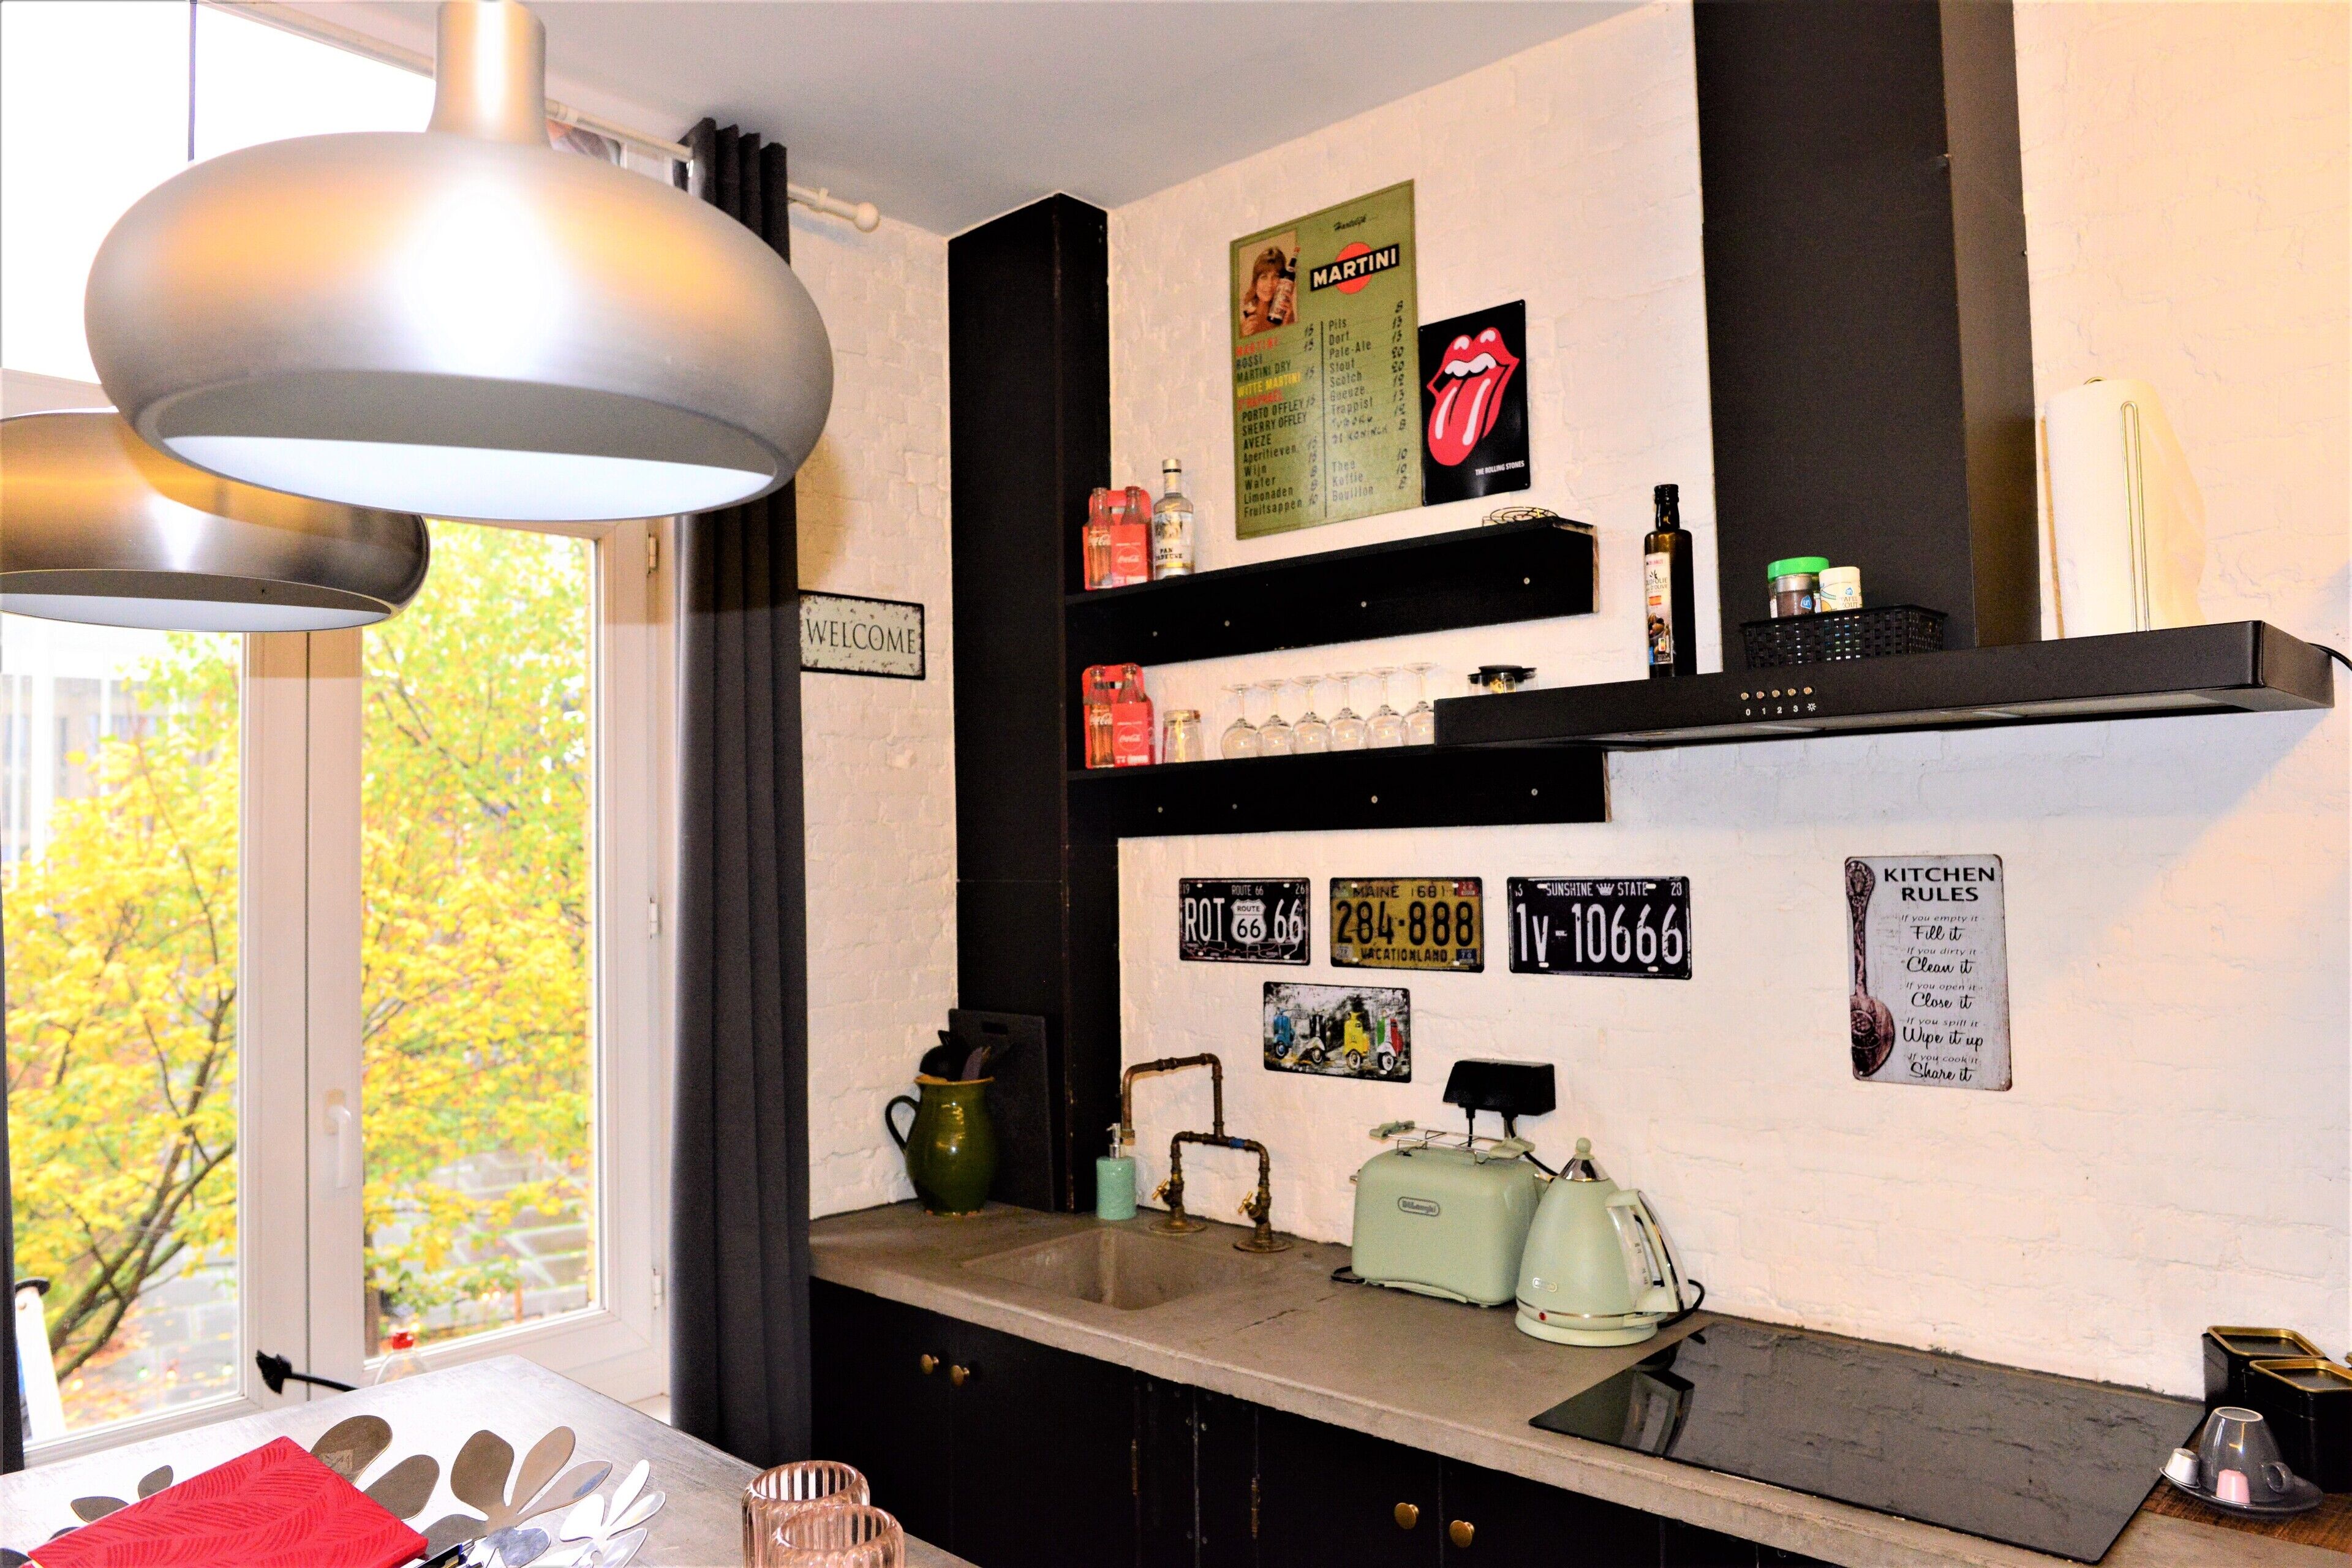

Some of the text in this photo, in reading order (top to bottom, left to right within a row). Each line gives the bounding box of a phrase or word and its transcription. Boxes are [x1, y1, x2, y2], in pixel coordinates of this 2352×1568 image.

[1313, 248, 1396, 287] MARTINI
[1329, 318, 1346, 331] Pils
[1329, 331, 1349, 345] Dort
[1330, 341, 1371, 360] Pale-Ale
[1236, 353, 1262, 369] ROSSI
[1330, 358, 1354, 374] Stout
[1237, 360, 1291, 382] MARTINI DRY
[1237, 381, 1262, 398] WITTE
[1265, 372, 1300, 391] MARTINI
[1330, 371, 1362, 388] Scotch
[1330, 386, 1365, 401] Gueuze
[1242, 407, 1268, 423] PORTO
[1272, 398, 1304, 416] OFFLEY
[1331, 396, 1373, 415] Trappist
[1242, 412, 1307, 436] SHERRY OFFLEY
[1243, 433, 1272, 450] AVEZE
[1245, 464, 1267, 477] Wijn
[1332, 460, 1355, 473] Thee
[1485, 464, 1505, 474] ROLLING
[1506, 460, 1525, 470] STONES
[1245, 477, 1276, 491] Water
[1333, 472, 1363, 487] Koffie
[1244, 486, 1293, 505] Limonaden
[1333, 486, 1373, 502] Bouillon
[1244, 499, 1302, 518] Fruitsappen
[805, 619, 916, 654] WELCOME
[1884, 867, 1995, 882] KITCHEN
[1231, 884, 1251, 895] ROUTE
[1255, 886, 1264, 895] 66
[1353, 885, 1400, 898] MAINE
[1547, 883, 1594, 896] SUNSHINE
[1618, 882, 1649, 896] STATE
[1901, 887, 1978, 902] RULES
[1185, 897, 1303, 944] ROT 66
[1237, 918, 1261, 938] 66
[1910, 925, 1965, 941] Fill it
[1360, 948, 1448, 962] VACATIONLAND
[1940, 948, 1965, 956] dirty
[1906, 956, 1977, 974] Clean it
[1911, 992, 1976, 1009] Close it
[1903, 1026, 1983, 1052] Wipe it up
[1943, 1055, 1967, 1063] cook
[1909, 1061, 1977, 1082] Share it
